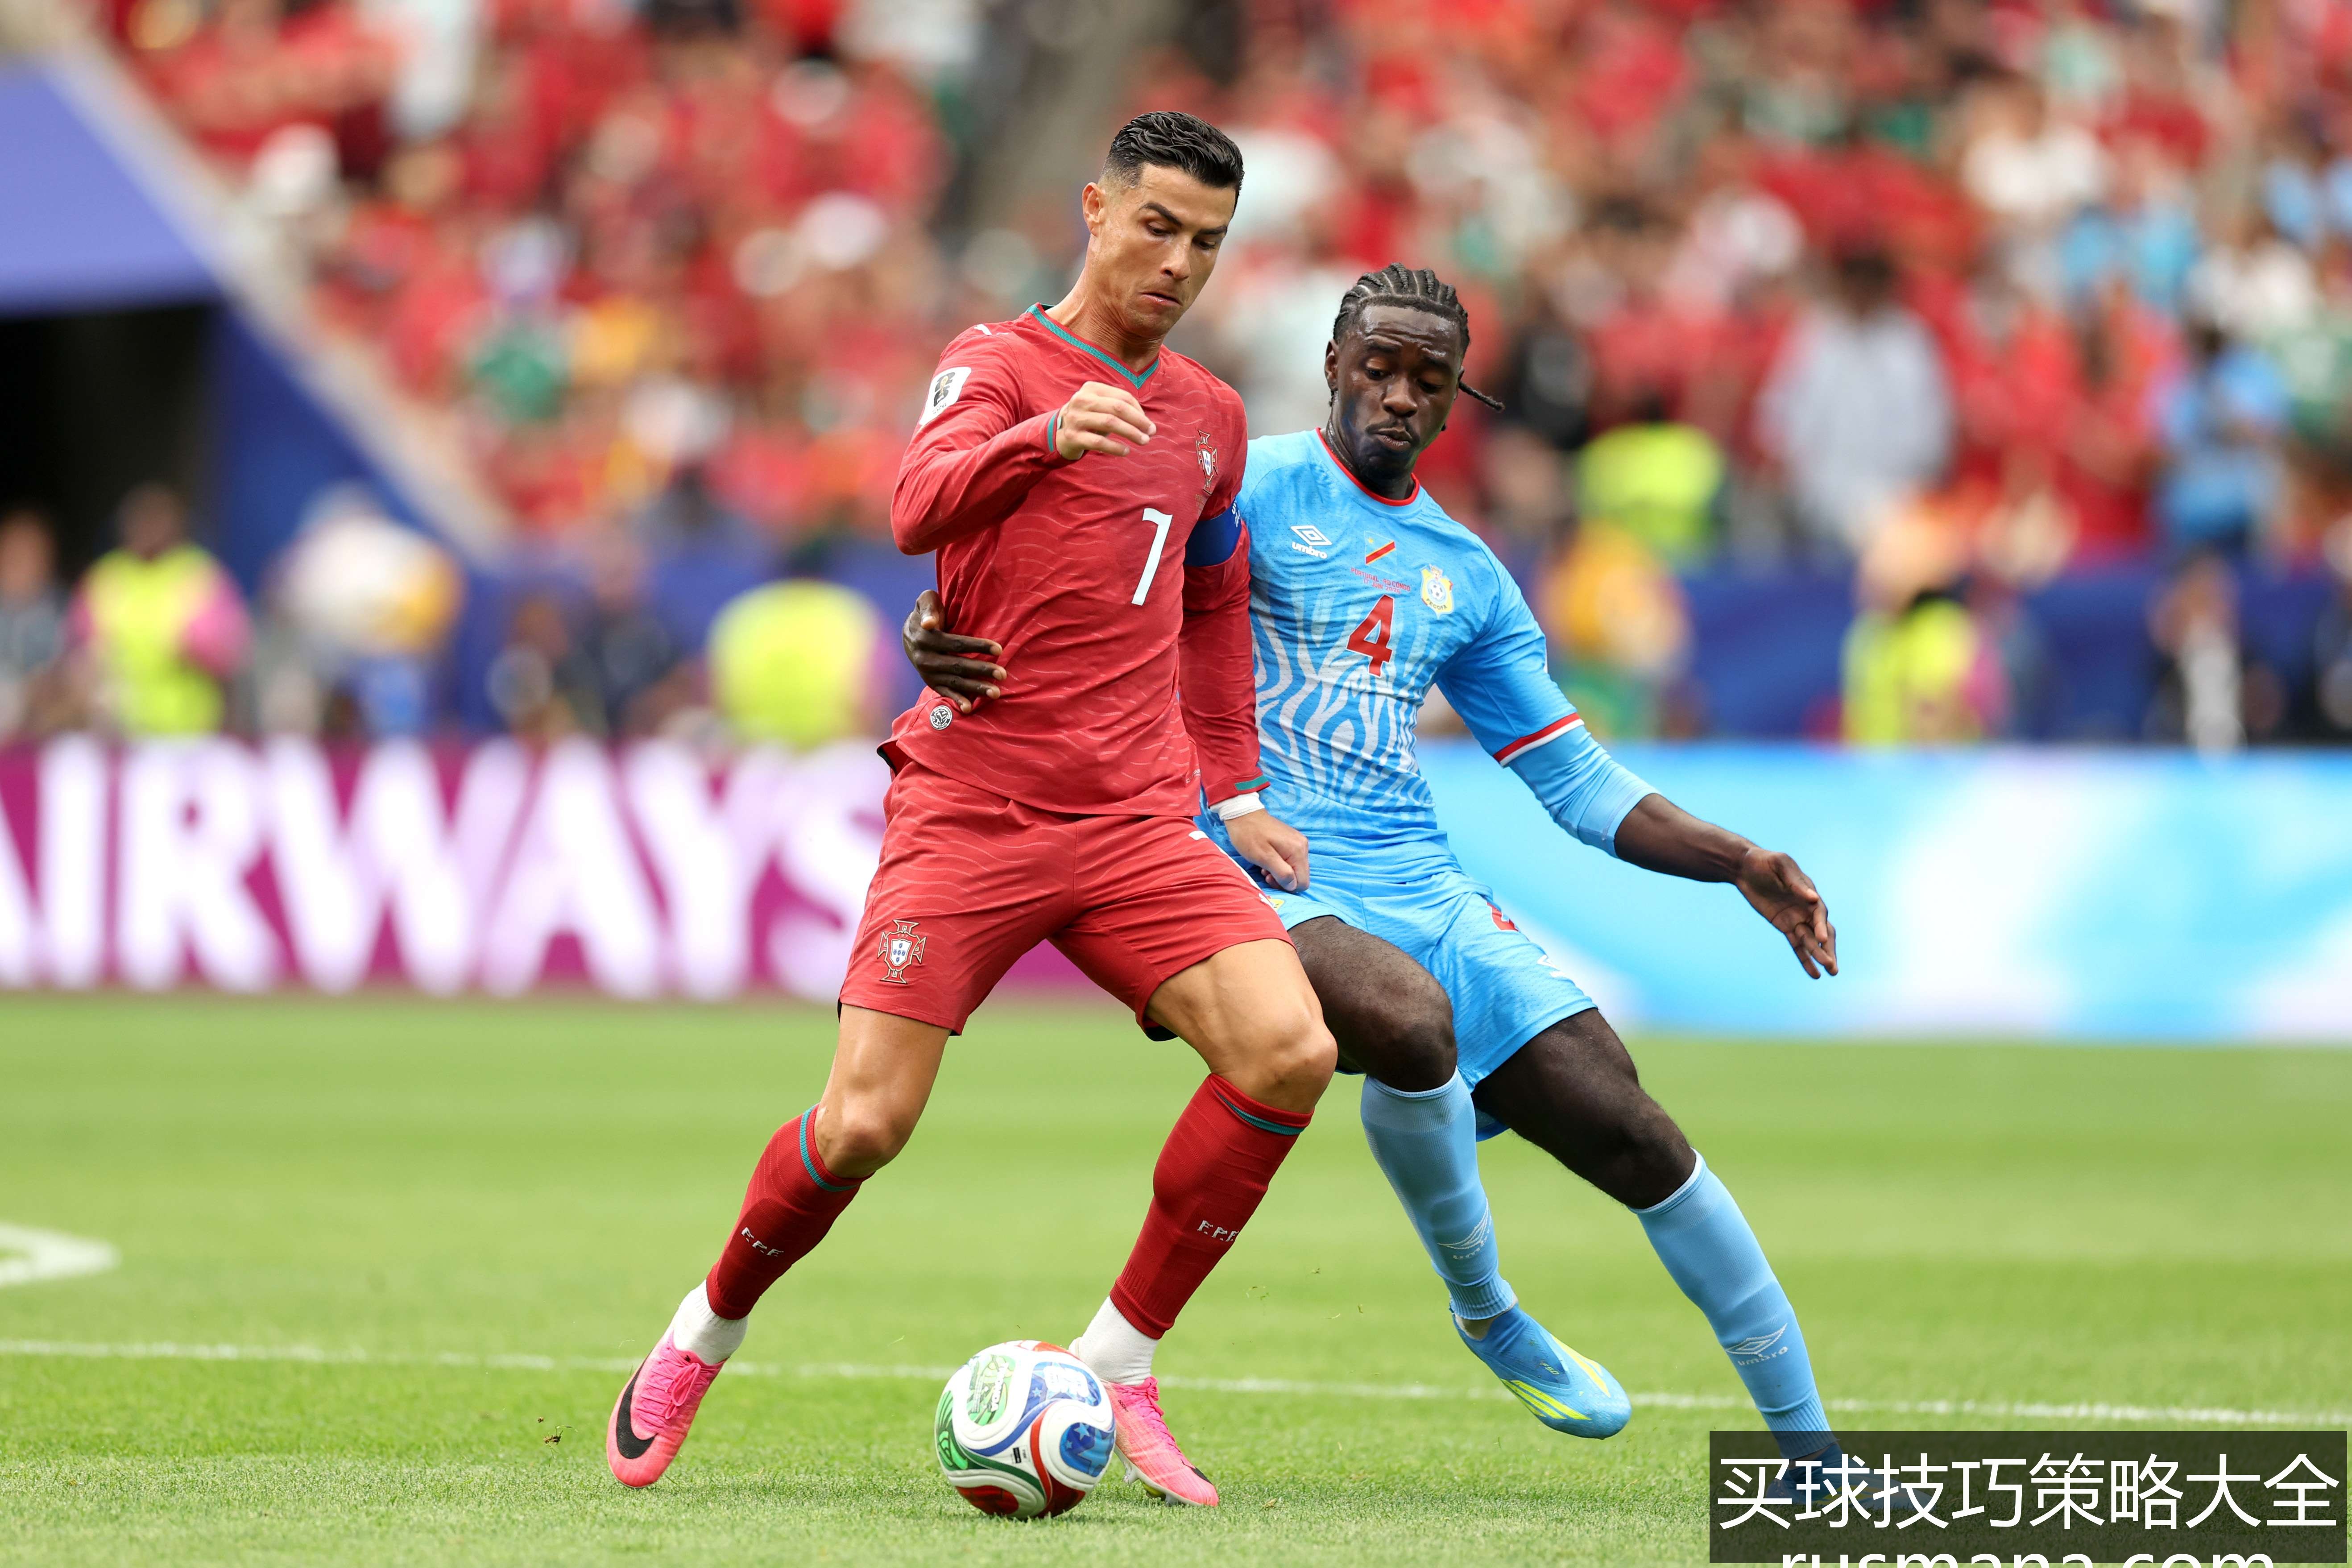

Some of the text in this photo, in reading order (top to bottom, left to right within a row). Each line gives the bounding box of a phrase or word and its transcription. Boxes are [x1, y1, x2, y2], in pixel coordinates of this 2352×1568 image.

[1131, 508, 1164, 606] 7
[1292, 541, 1328, 559] umbro
[1351, 567, 1379, 582] PORTUGAL
[1392, 581, 1410, 591] CONGO
[1346, 594, 1394, 677] 4
[0, 734, 888, 1001] IRWAYS
